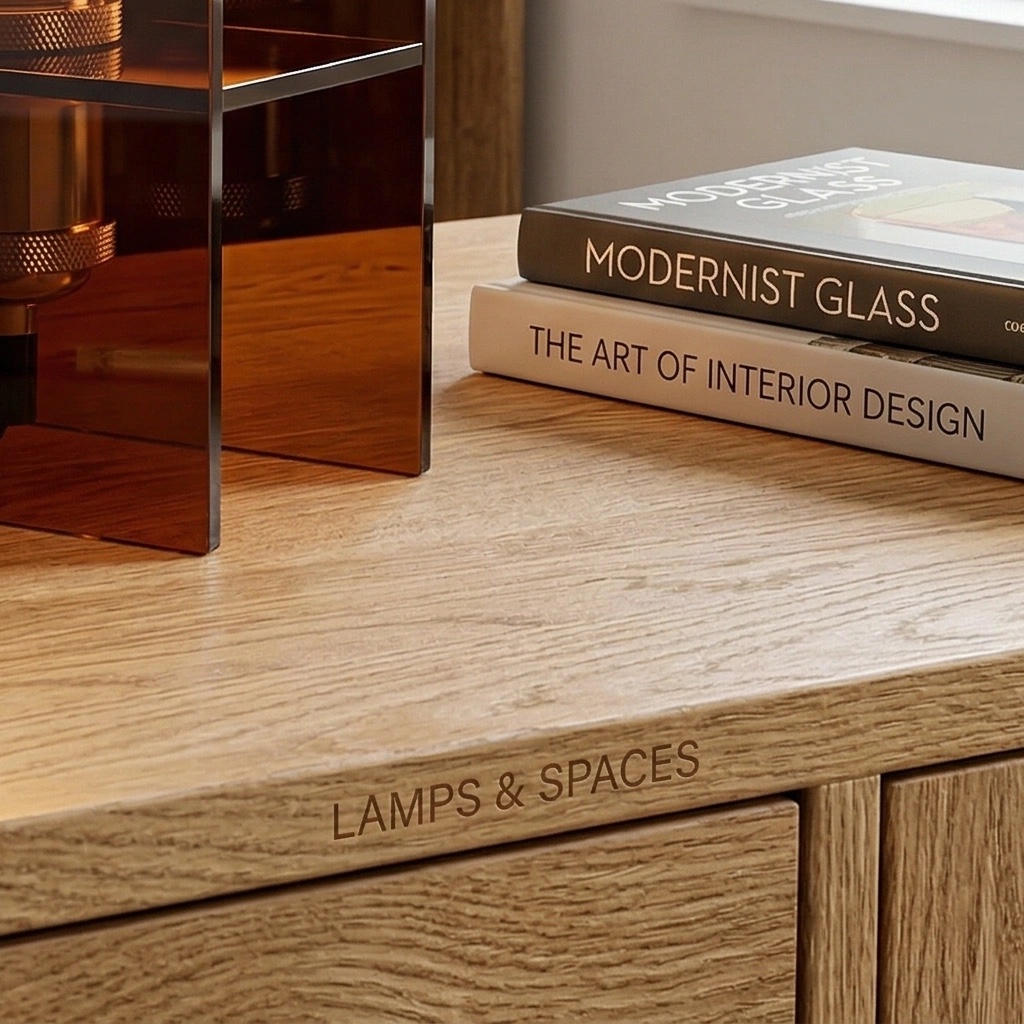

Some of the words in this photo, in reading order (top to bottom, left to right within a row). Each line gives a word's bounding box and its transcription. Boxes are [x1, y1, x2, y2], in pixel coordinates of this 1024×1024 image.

[618, 156, 890, 211] MODERNIST
[736, 175, 902, 210] GLASS
[585, 237, 804, 308] MODERNIST
[816, 277, 940, 332] GLASS
[529, 325, 583, 364] THE
[592, 338, 648, 375] ART
[657, 350, 697, 384] OF
[708, 358, 852, 416] INTERIOR
[863, 388, 986, 442] DESIGN
[333, 778, 481, 840] LAMPS
[495, 771, 525, 811] &
[539, 740, 700, 802] SPACES
